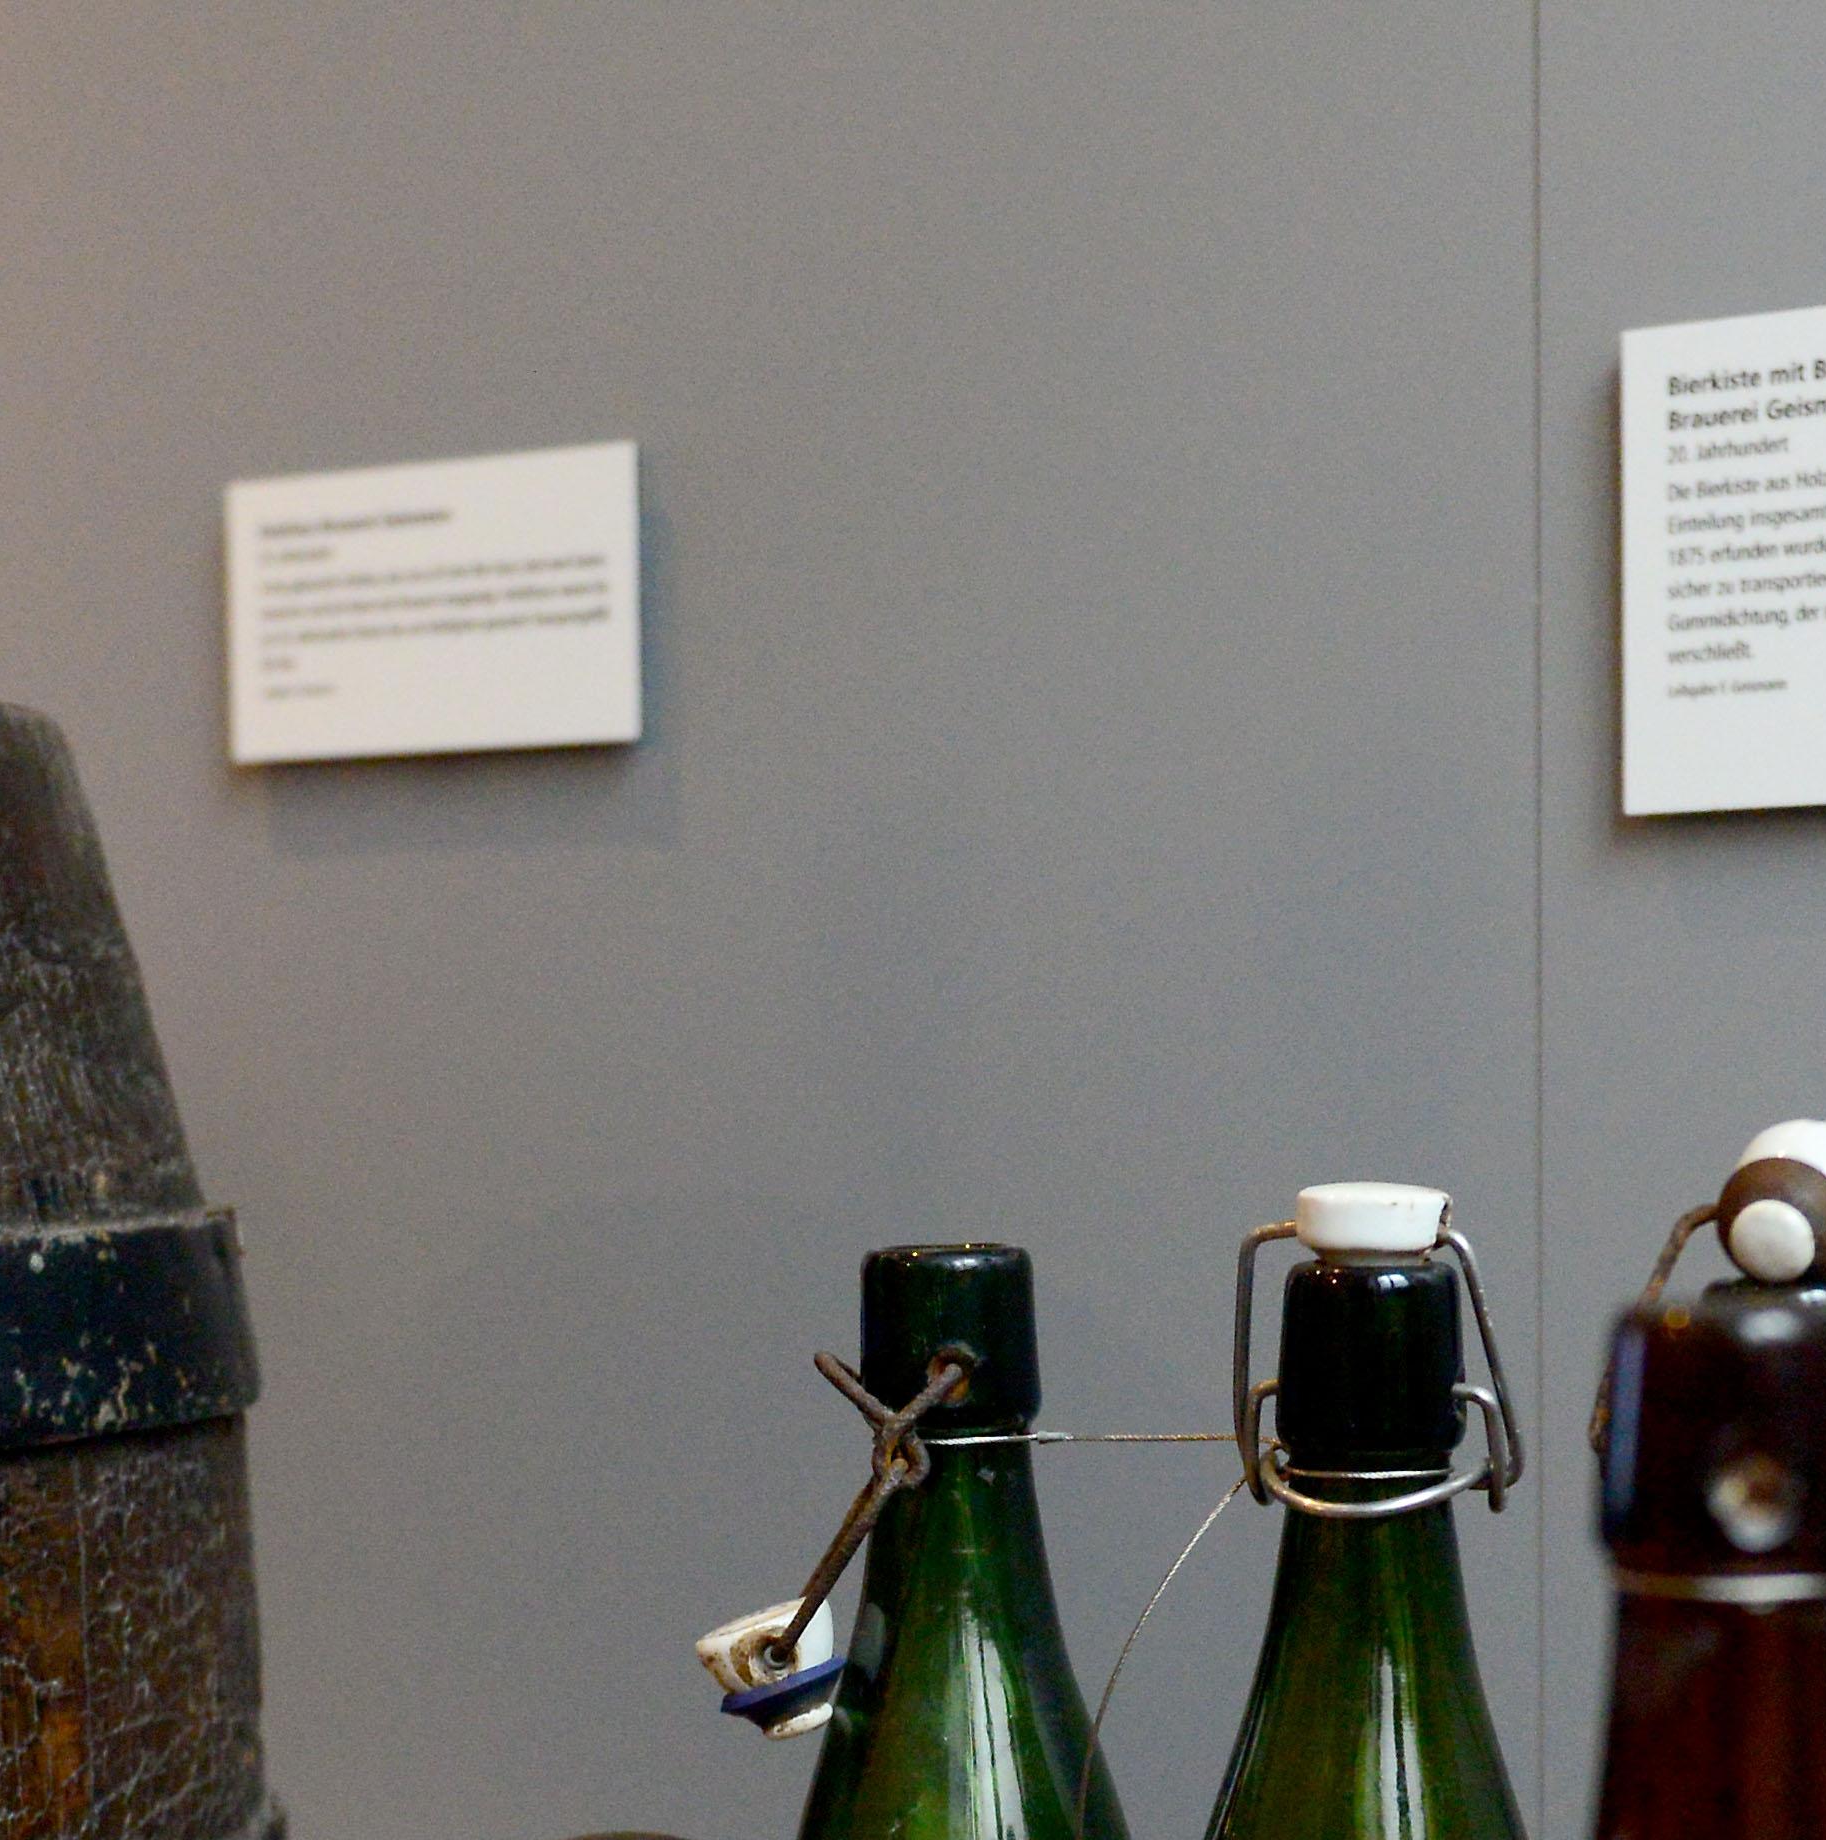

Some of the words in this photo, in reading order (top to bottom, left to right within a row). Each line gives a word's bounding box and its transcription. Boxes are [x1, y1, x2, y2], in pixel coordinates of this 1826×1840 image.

[1668, 368, 1761, 396] Bierkiste
[1770, 363, 1805, 383] mit
[1668, 404, 1759, 430] Brauerei
[1699, 436, 1788, 461] Jahrhundert
[1668, 482, 1690, 502] Die
[1697, 475, 1759, 499] Bierkiste
[1765, 476, 1790, 492] aus
[1796, 469, 1826, 490] Holz
[1668, 511, 1744, 535] Einteilung
[1668, 546, 1705, 567] 1875
[1711, 540, 1778, 563] erfunden
[1668, 579, 1710, 600] sicher
[1716, 580, 1733, 595] zu
[1796, 603, 1818, 621] der
